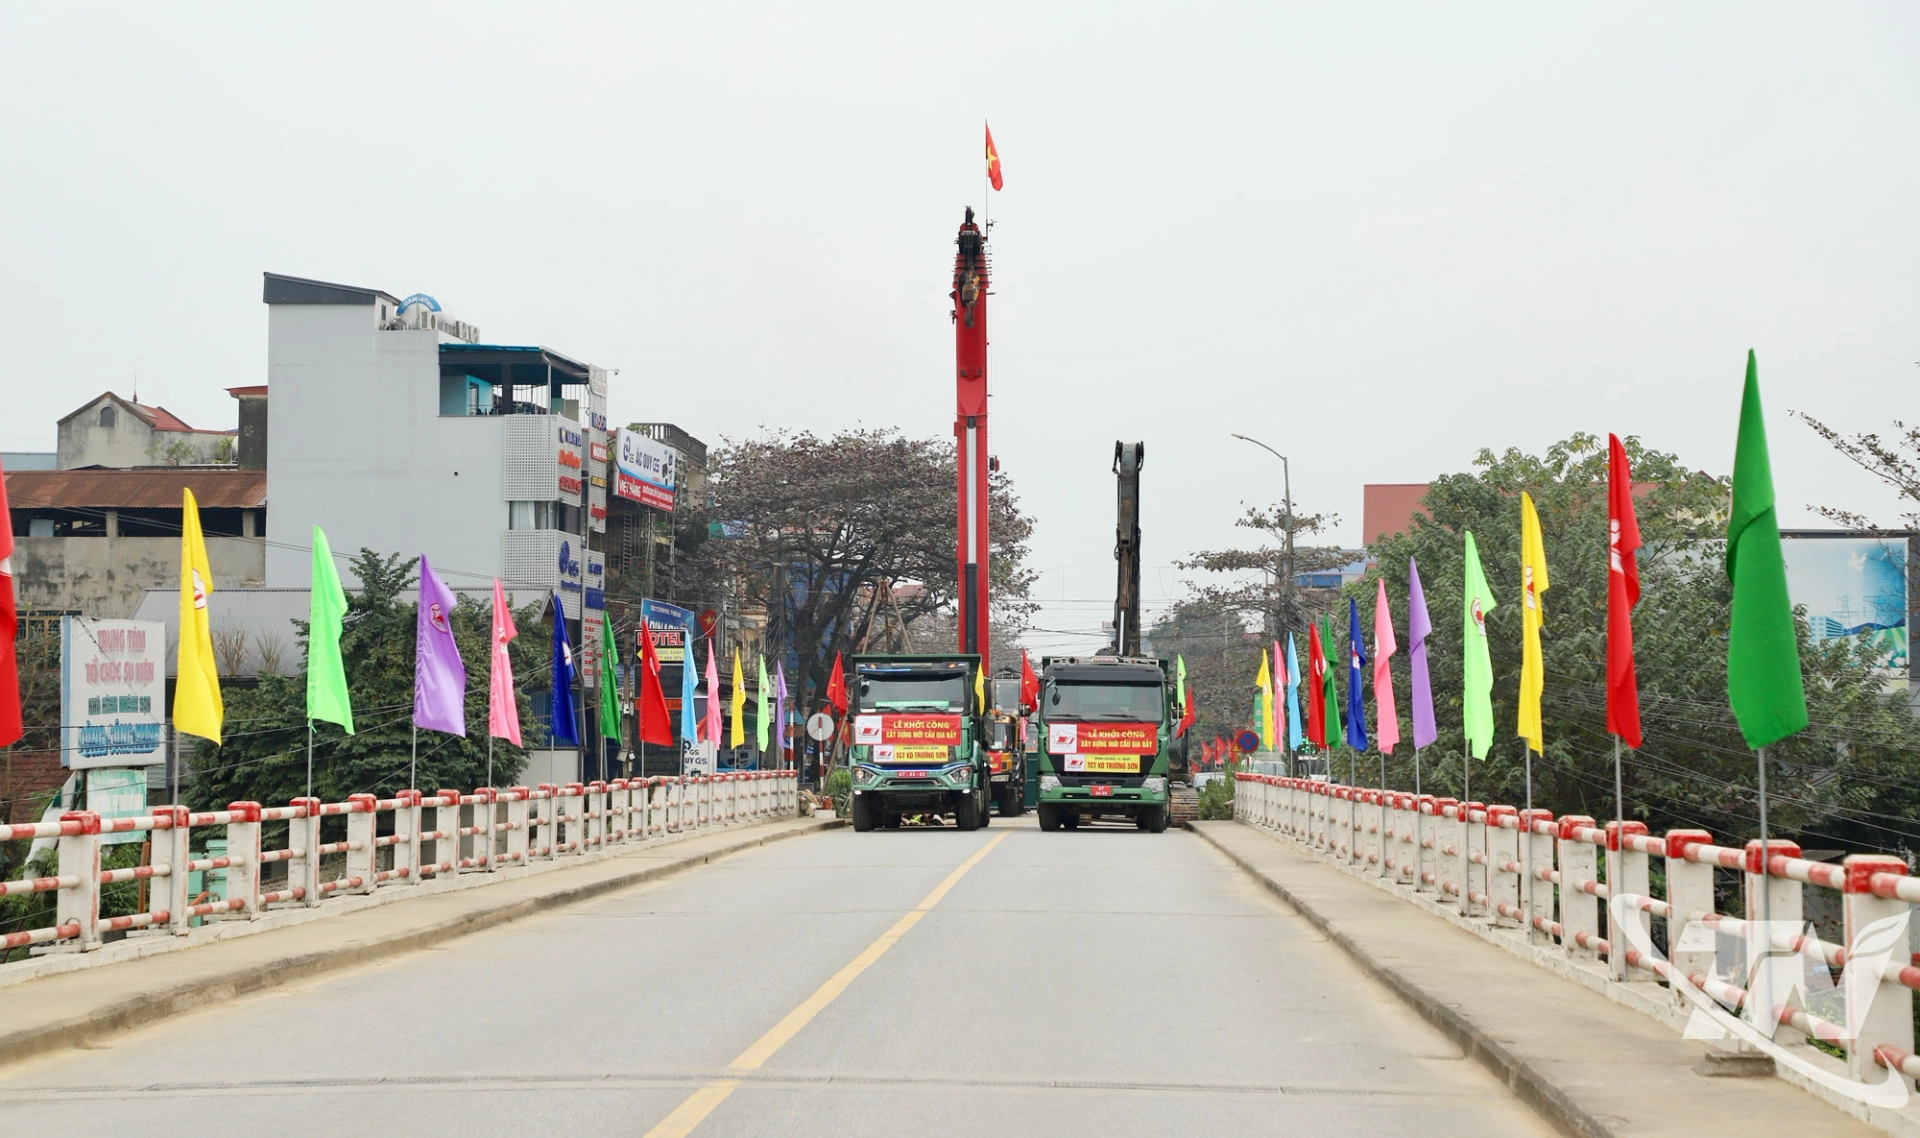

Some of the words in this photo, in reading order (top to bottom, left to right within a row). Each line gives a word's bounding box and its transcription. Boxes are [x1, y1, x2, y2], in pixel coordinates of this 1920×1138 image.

[653, 457, 660, 473] GS
[97, 629, 125, 651] TRUNG
[127, 625, 146, 651] TÂM
[85, 654, 98, 684] TỔ
[894, 720, 902, 728] LỄ
[904, 720, 924, 728] KHỞI
[926, 720, 950, 728] CÔNG
[1088, 728, 1098, 738] LỄ
[1099, 729, 1120, 738] KHỞI
[1121, 729, 1145, 738] CÔNG
[896, 751, 905, 759] TCT
[695, 757, 708, 765] GS
